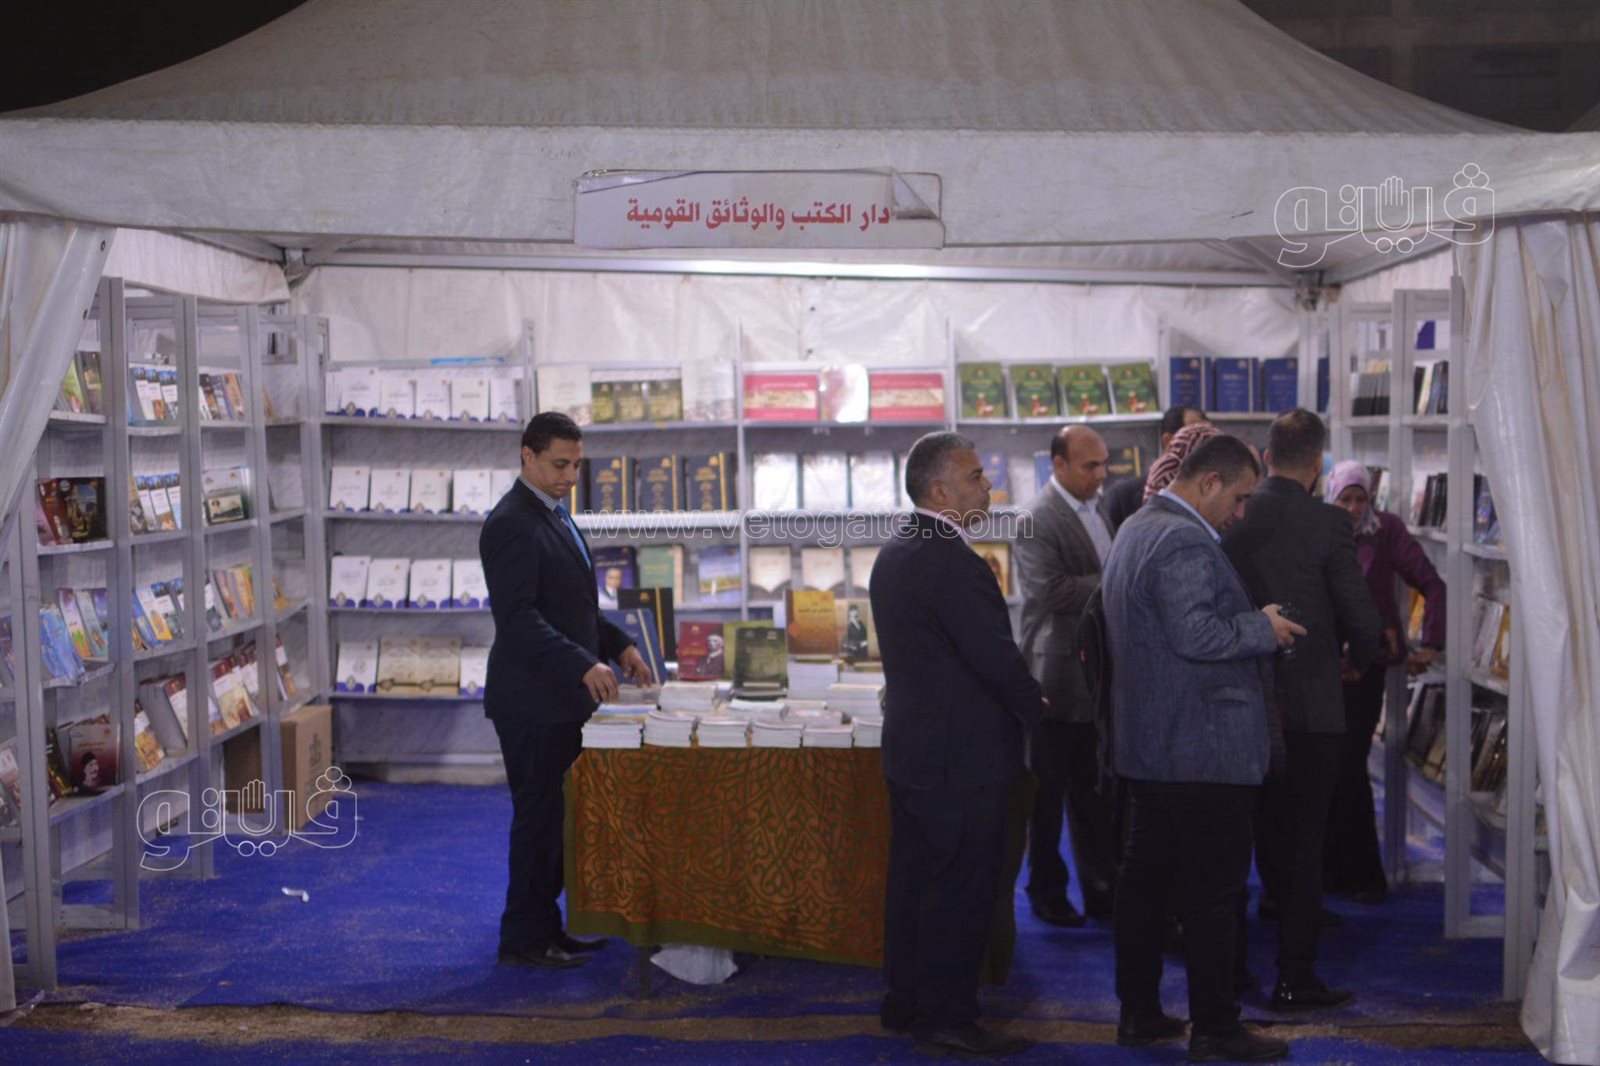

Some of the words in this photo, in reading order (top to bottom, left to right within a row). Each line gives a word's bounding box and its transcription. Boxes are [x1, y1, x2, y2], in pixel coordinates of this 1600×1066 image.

[626, 198, 700, 230] القومية
[705, 196, 785, 231] والوثائق
[791, 200, 852, 231] الكتب
[859, 203, 890, 232] دار
